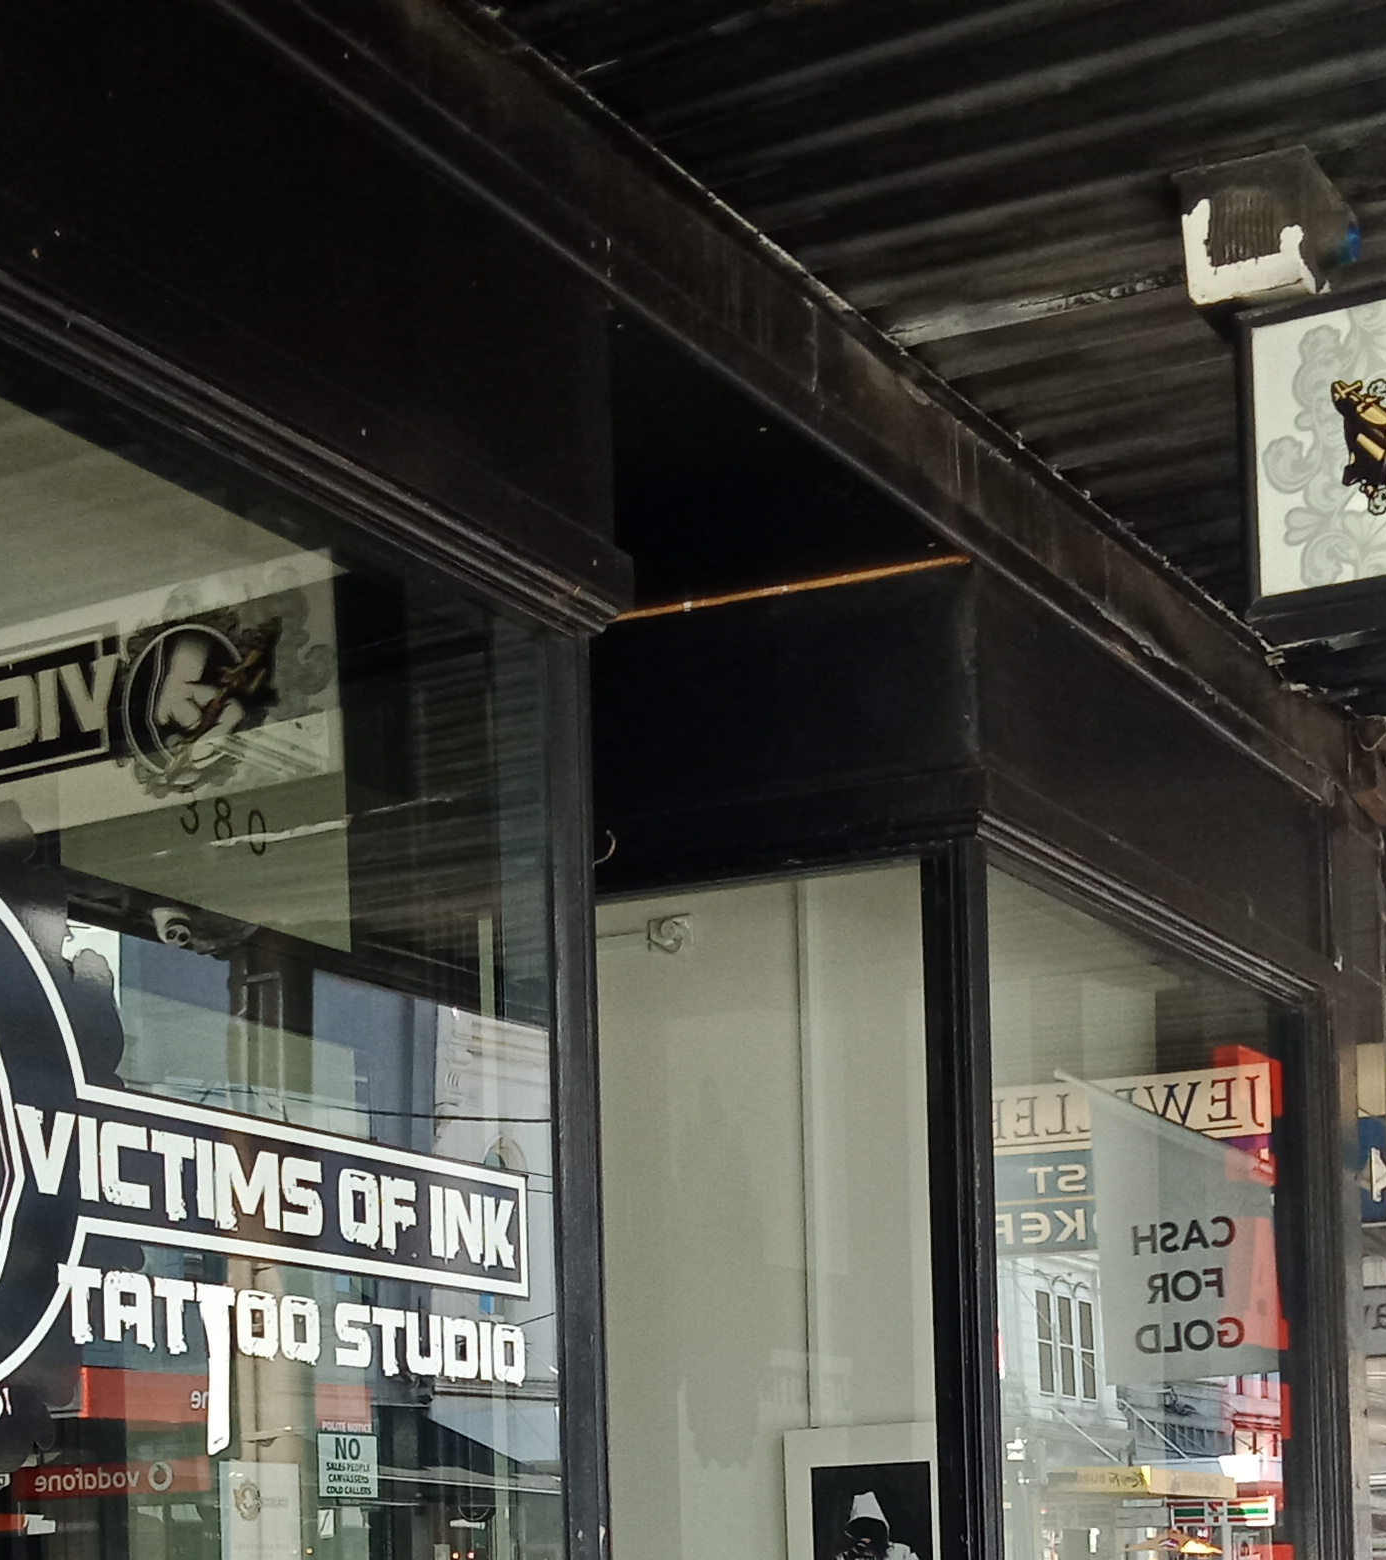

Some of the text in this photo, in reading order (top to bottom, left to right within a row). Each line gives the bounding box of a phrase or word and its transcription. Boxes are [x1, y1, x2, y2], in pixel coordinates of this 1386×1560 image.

[14, 1103, 516, 1270] VICTIMS OF INK
[56, 1263, 527, 1455] TATTOO STUDIO
[335, 1437, 360, 1460] NO
